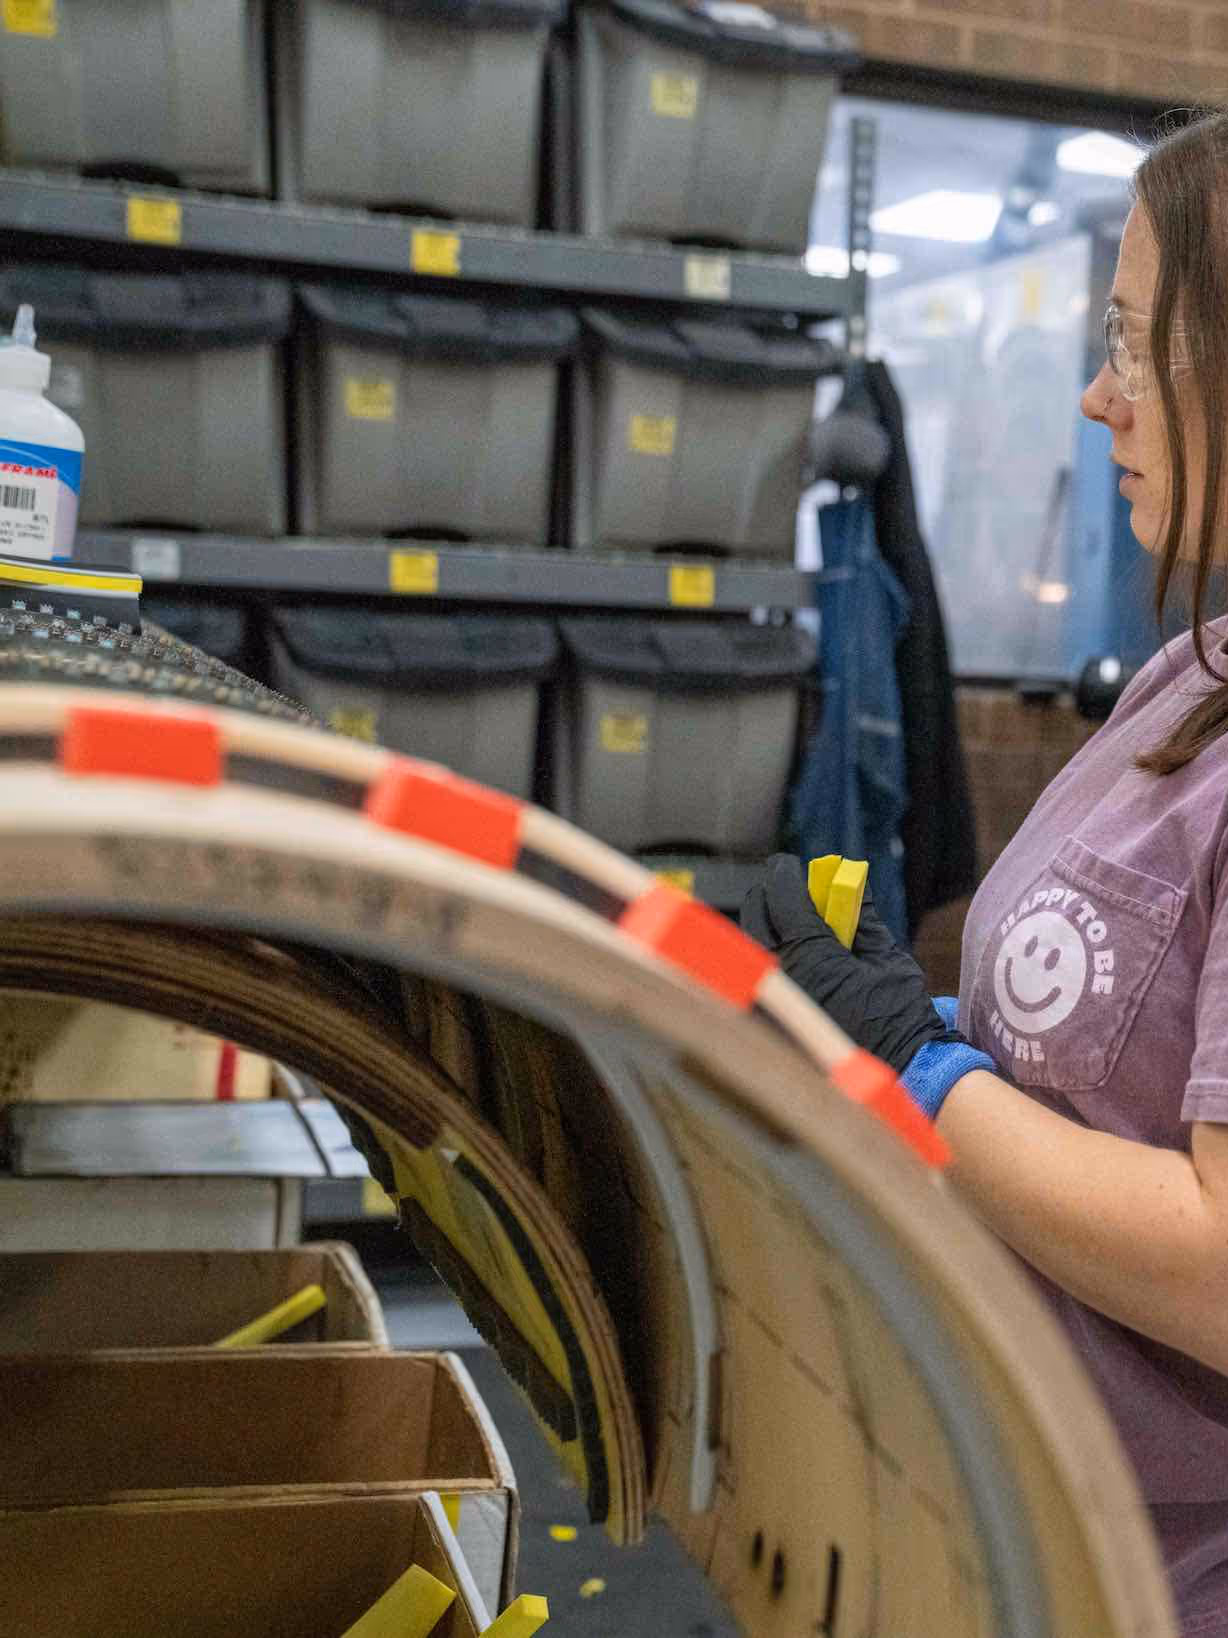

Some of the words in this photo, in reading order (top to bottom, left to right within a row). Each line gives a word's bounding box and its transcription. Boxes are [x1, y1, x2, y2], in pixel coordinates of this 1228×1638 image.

[1000, 888, 1080, 936] HAPPY
[1076, 901, 1107, 943] TO
[1092, 949, 1115, 994] BE
[990, 1010, 1045, 1061] HERE
